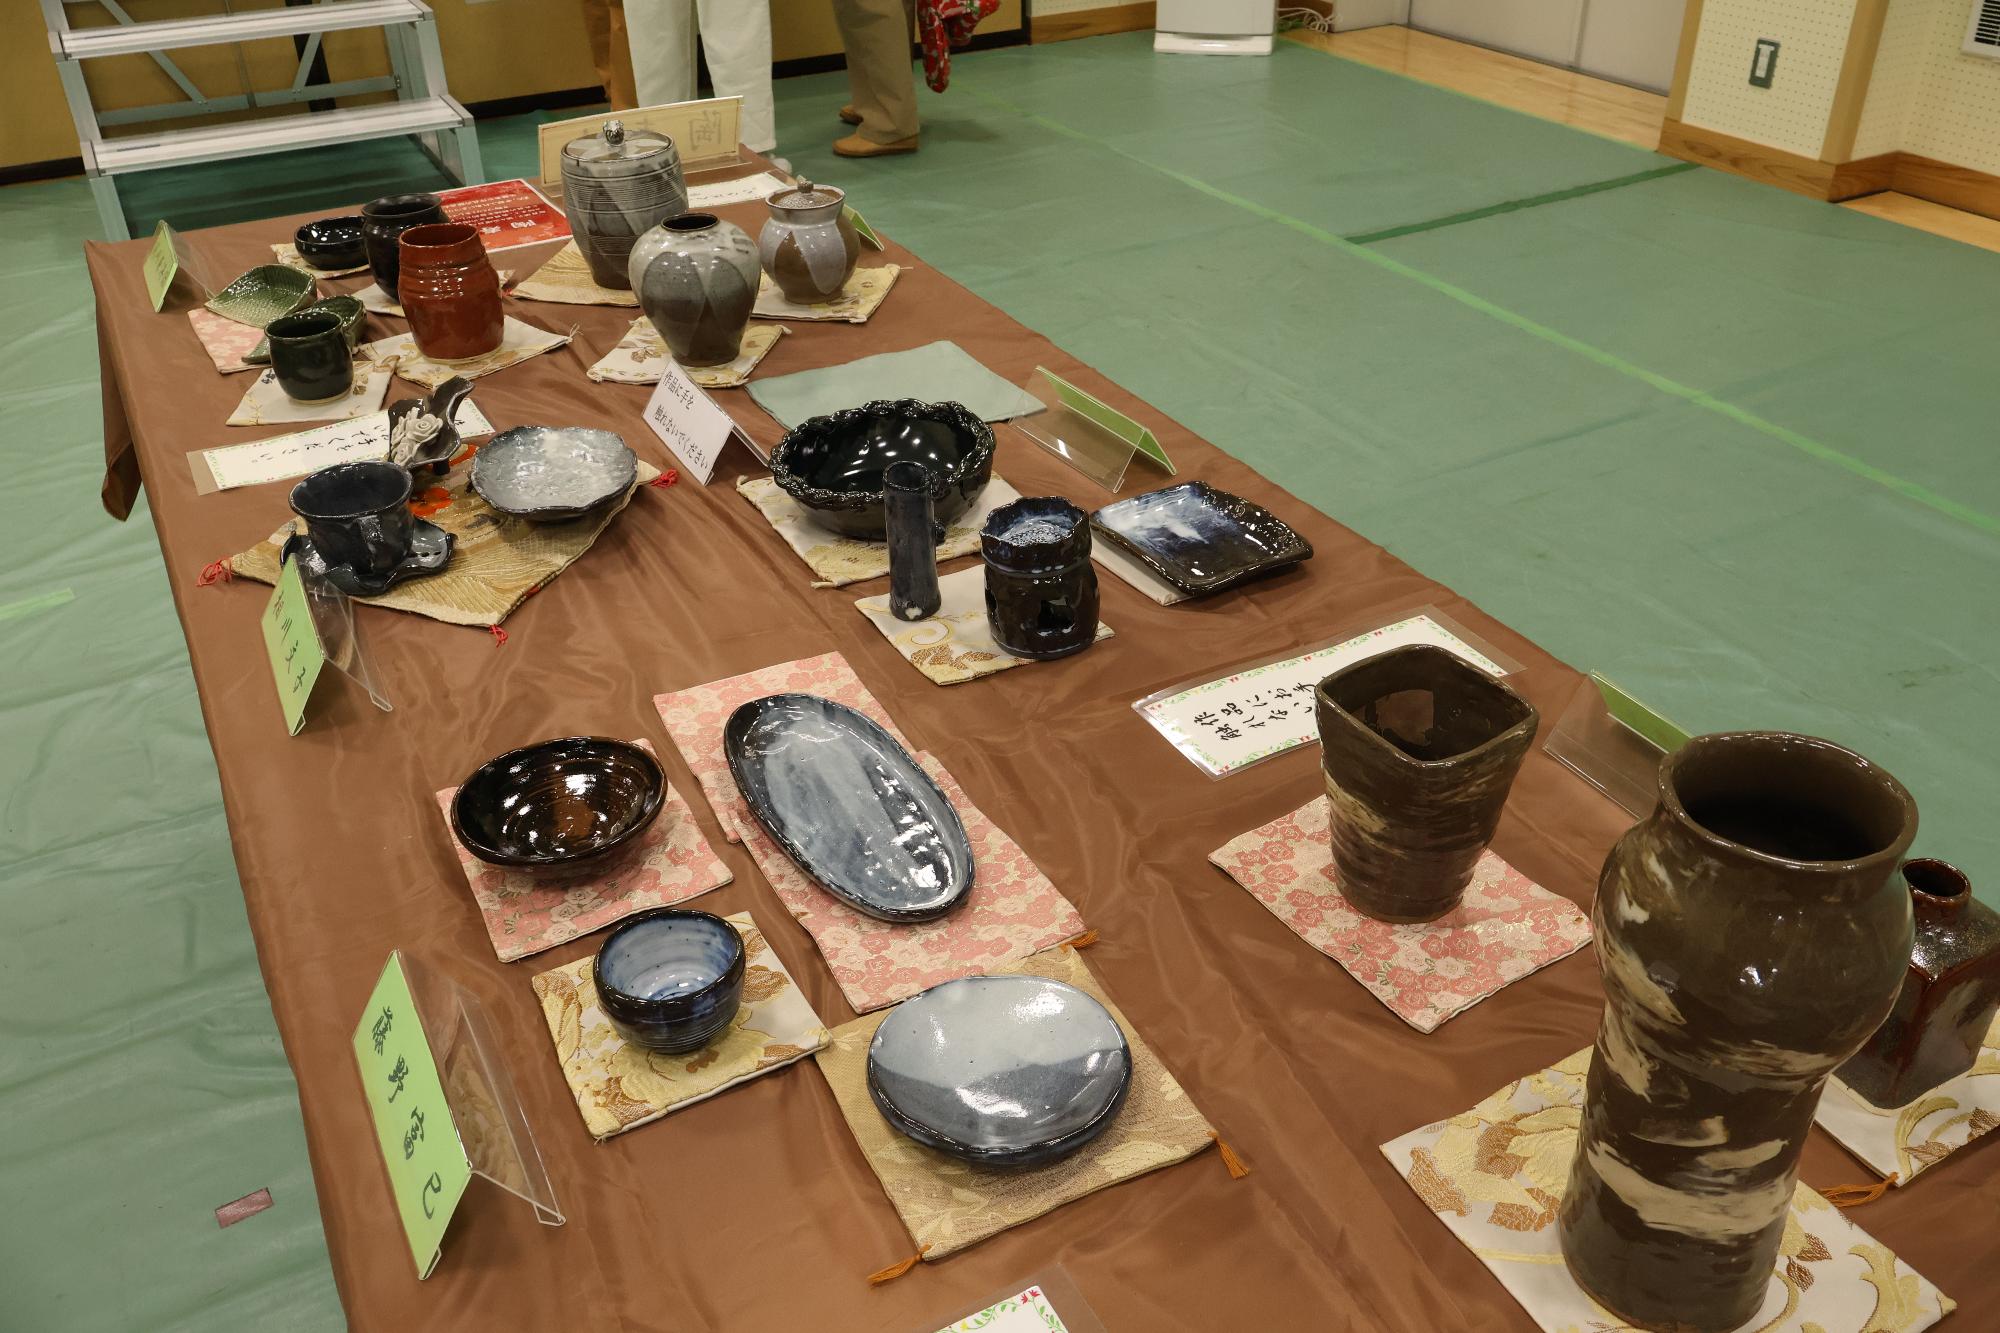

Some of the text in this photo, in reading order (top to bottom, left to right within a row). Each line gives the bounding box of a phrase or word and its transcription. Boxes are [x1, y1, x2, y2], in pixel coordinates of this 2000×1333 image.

[664, 371, 695, 410] 作品に手を
[654, 404, 708, 469] 触れないでください
[1193, 678, 1324, 726] 作品にお手
[1215, 696, 1316, 740] 触れない
